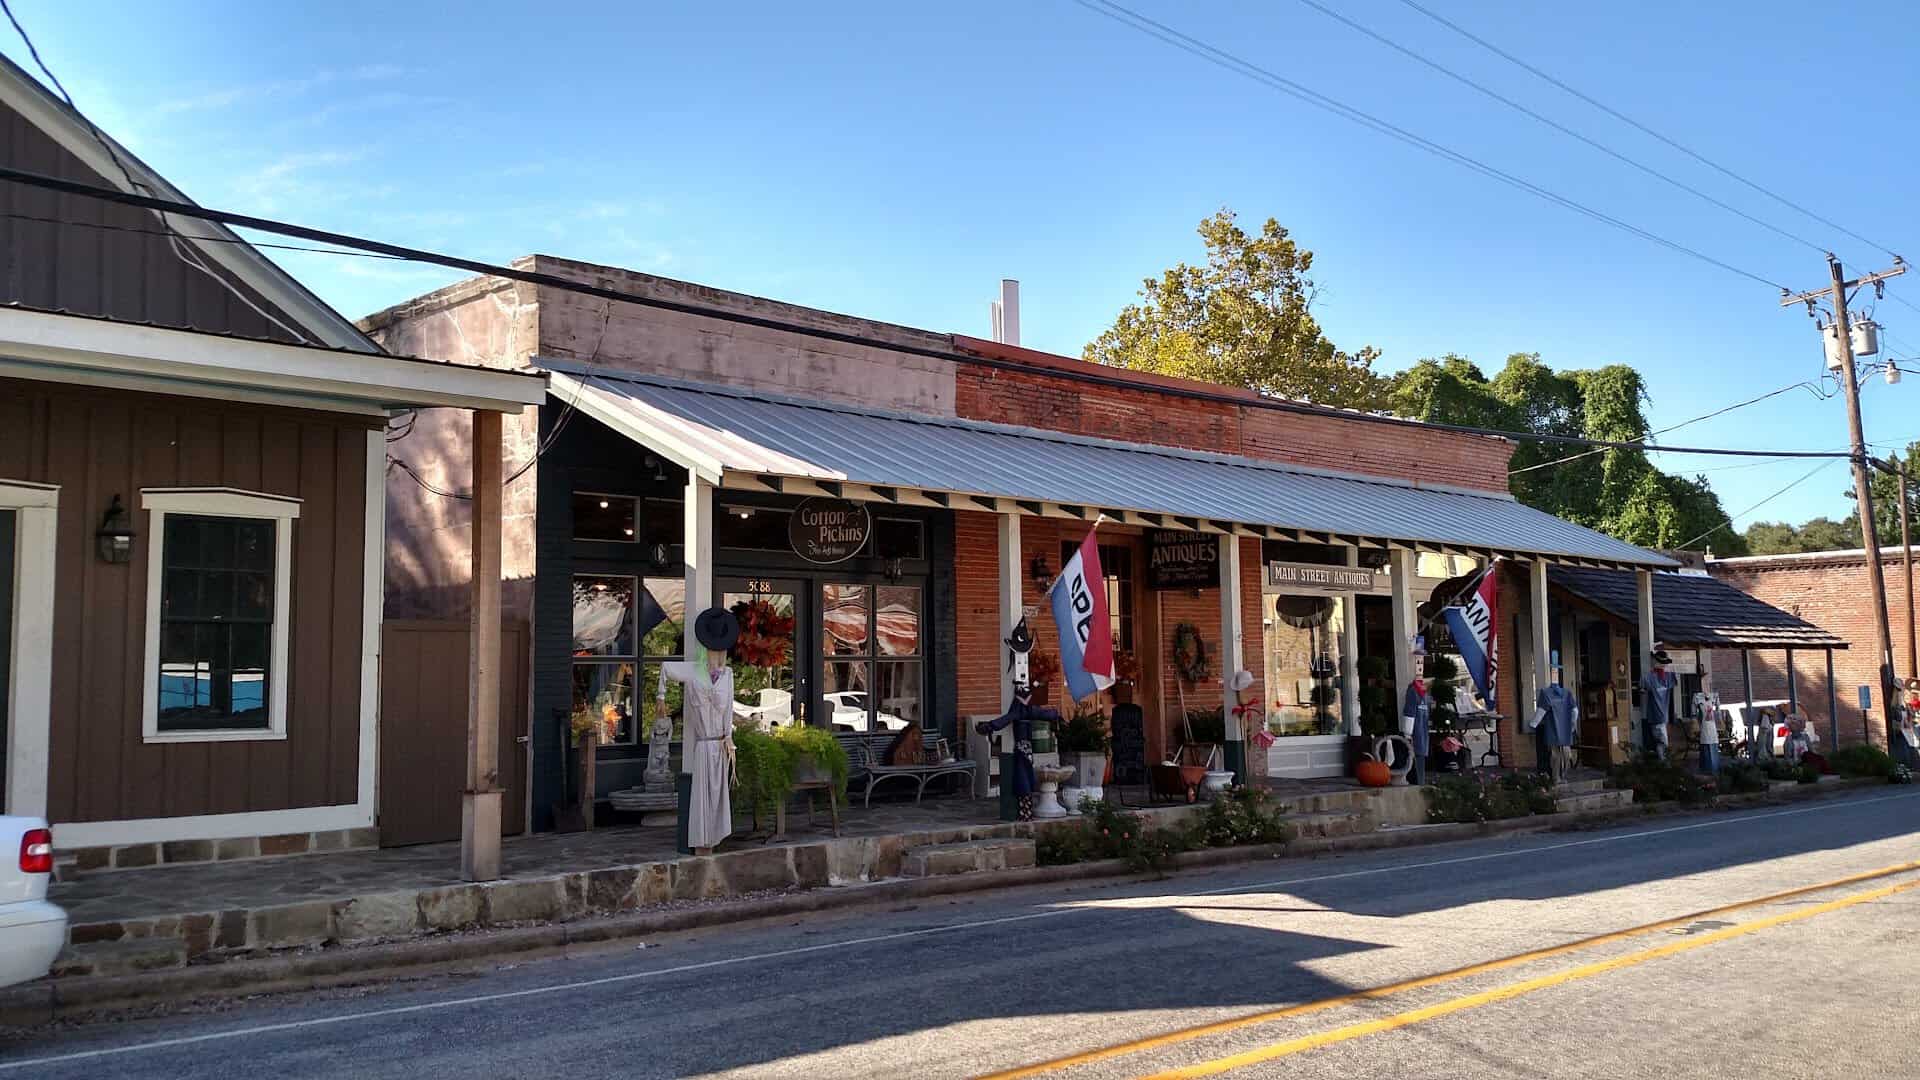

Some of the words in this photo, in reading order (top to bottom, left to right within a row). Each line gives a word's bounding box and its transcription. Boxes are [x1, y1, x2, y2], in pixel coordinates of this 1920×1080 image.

[1151, 543, 1216, 568] ANTIQUES
[1275, 567, 1296, 580] MAIN
[1301, 568, 1329, 583] STREET
[1334, 571, 1370, 585] ANTIQUES
